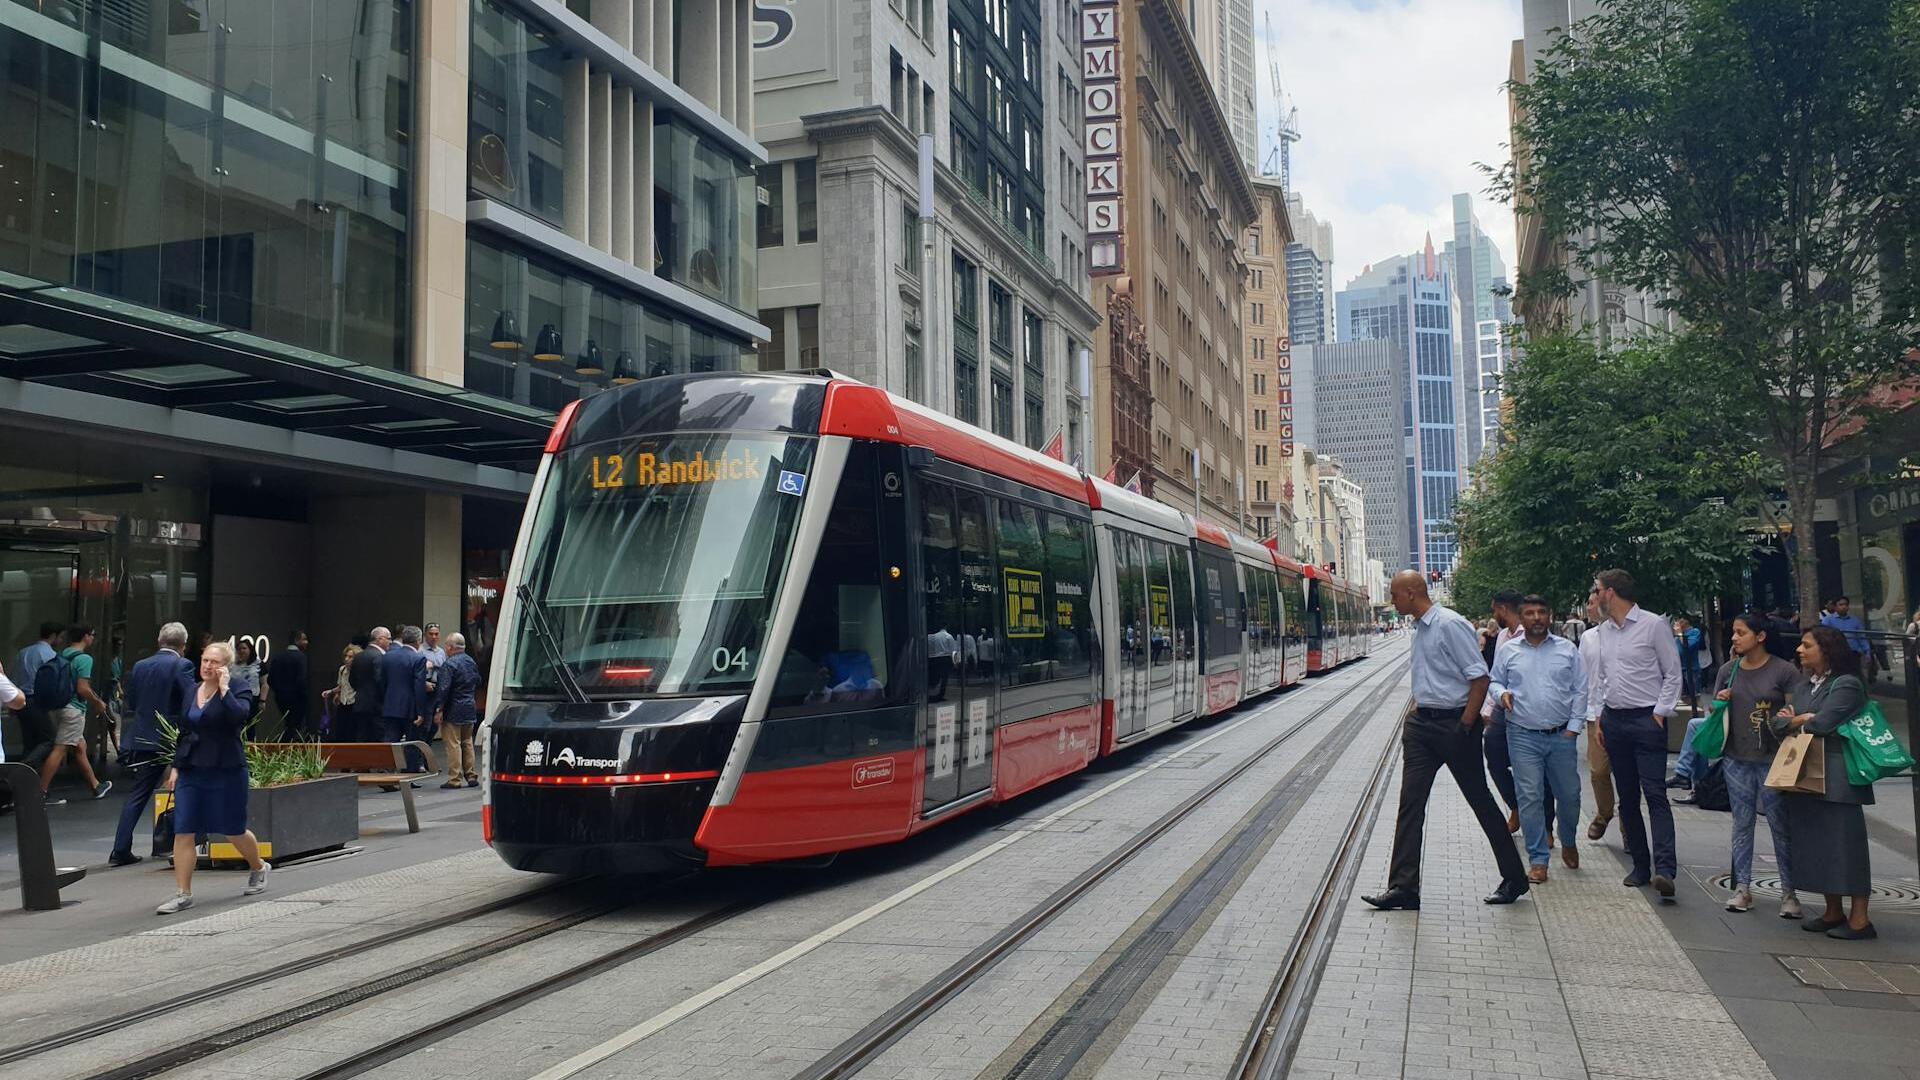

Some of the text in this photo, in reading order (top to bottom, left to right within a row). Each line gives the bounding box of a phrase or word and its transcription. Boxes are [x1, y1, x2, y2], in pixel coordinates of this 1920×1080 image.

[1279, 338, 1292, 456] GOWINGS
[593, 448, 760, 489] L2 Randwick
[712, 646, 749, 672] 04
[525, 754, 543, 763] NSW
[576, 756, 623, 769] Transport
